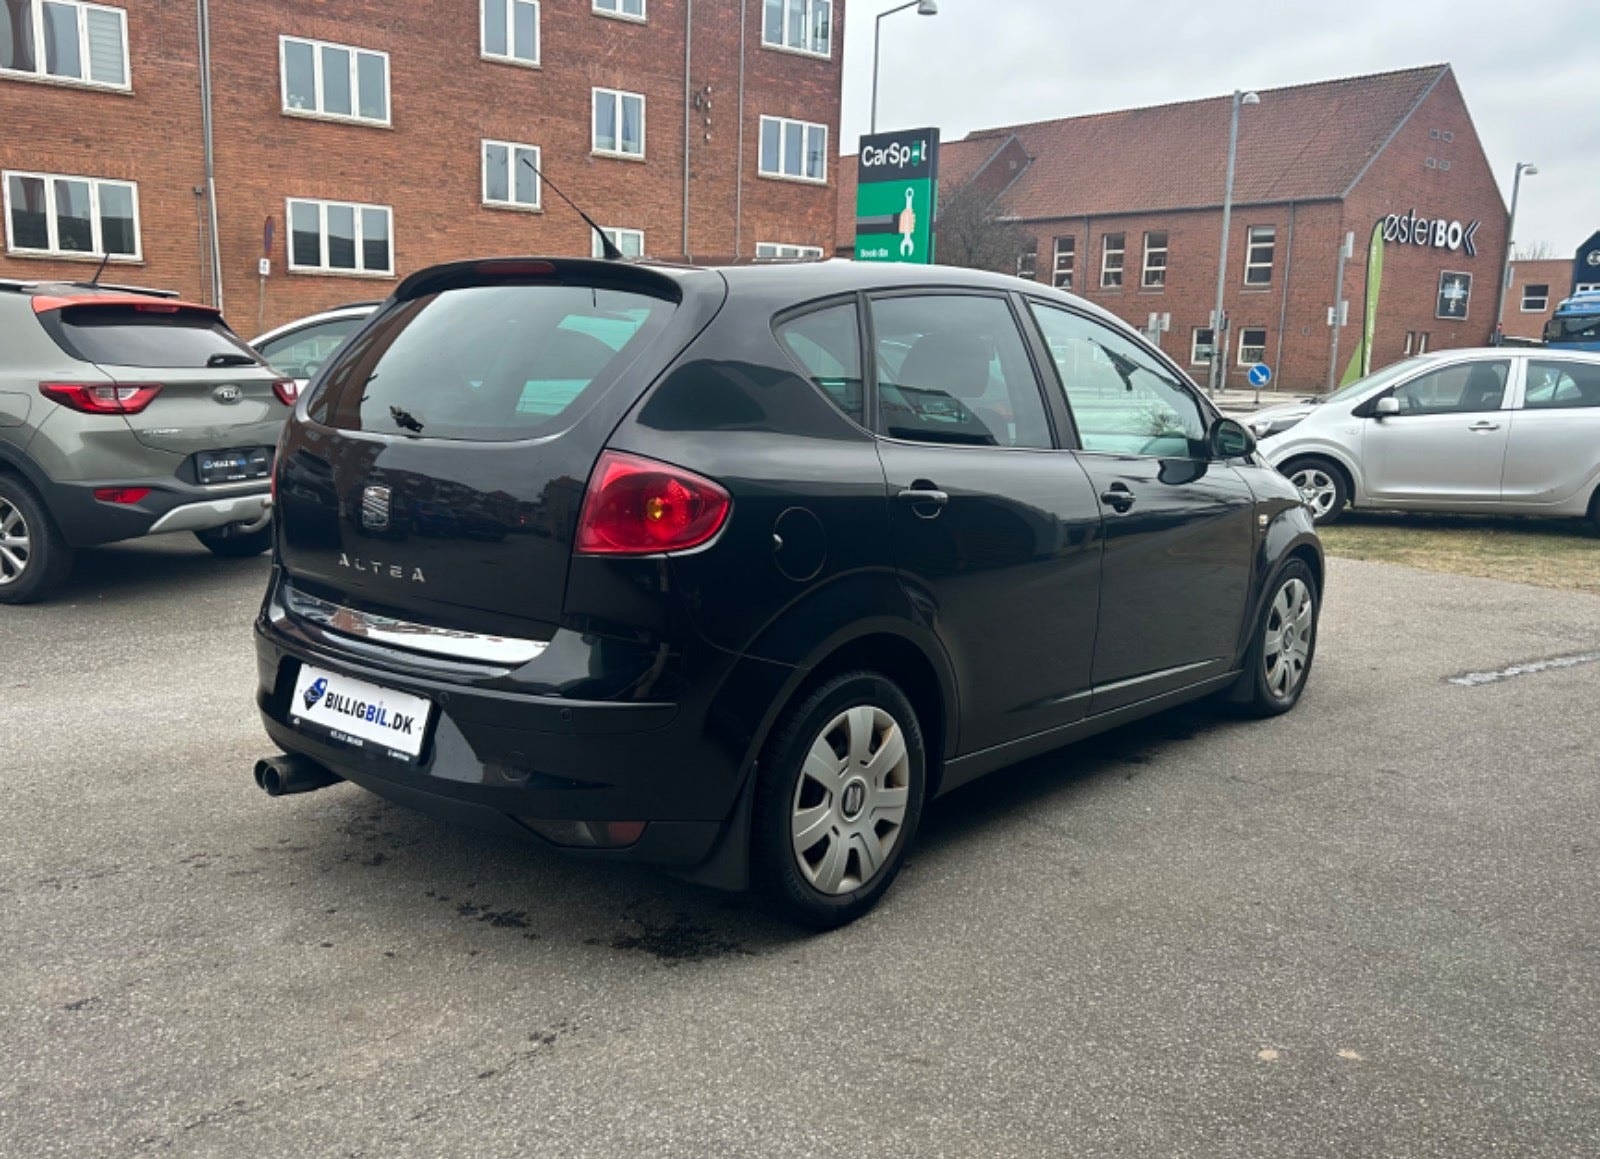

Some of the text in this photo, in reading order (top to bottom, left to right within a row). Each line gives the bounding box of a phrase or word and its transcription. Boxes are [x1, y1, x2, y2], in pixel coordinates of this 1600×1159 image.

[862, 140, 927, 168] CarSpot
[338, 553, 426, 582] ALTEA
[324, 692, 415, 735] BILLIGBIL.DK
